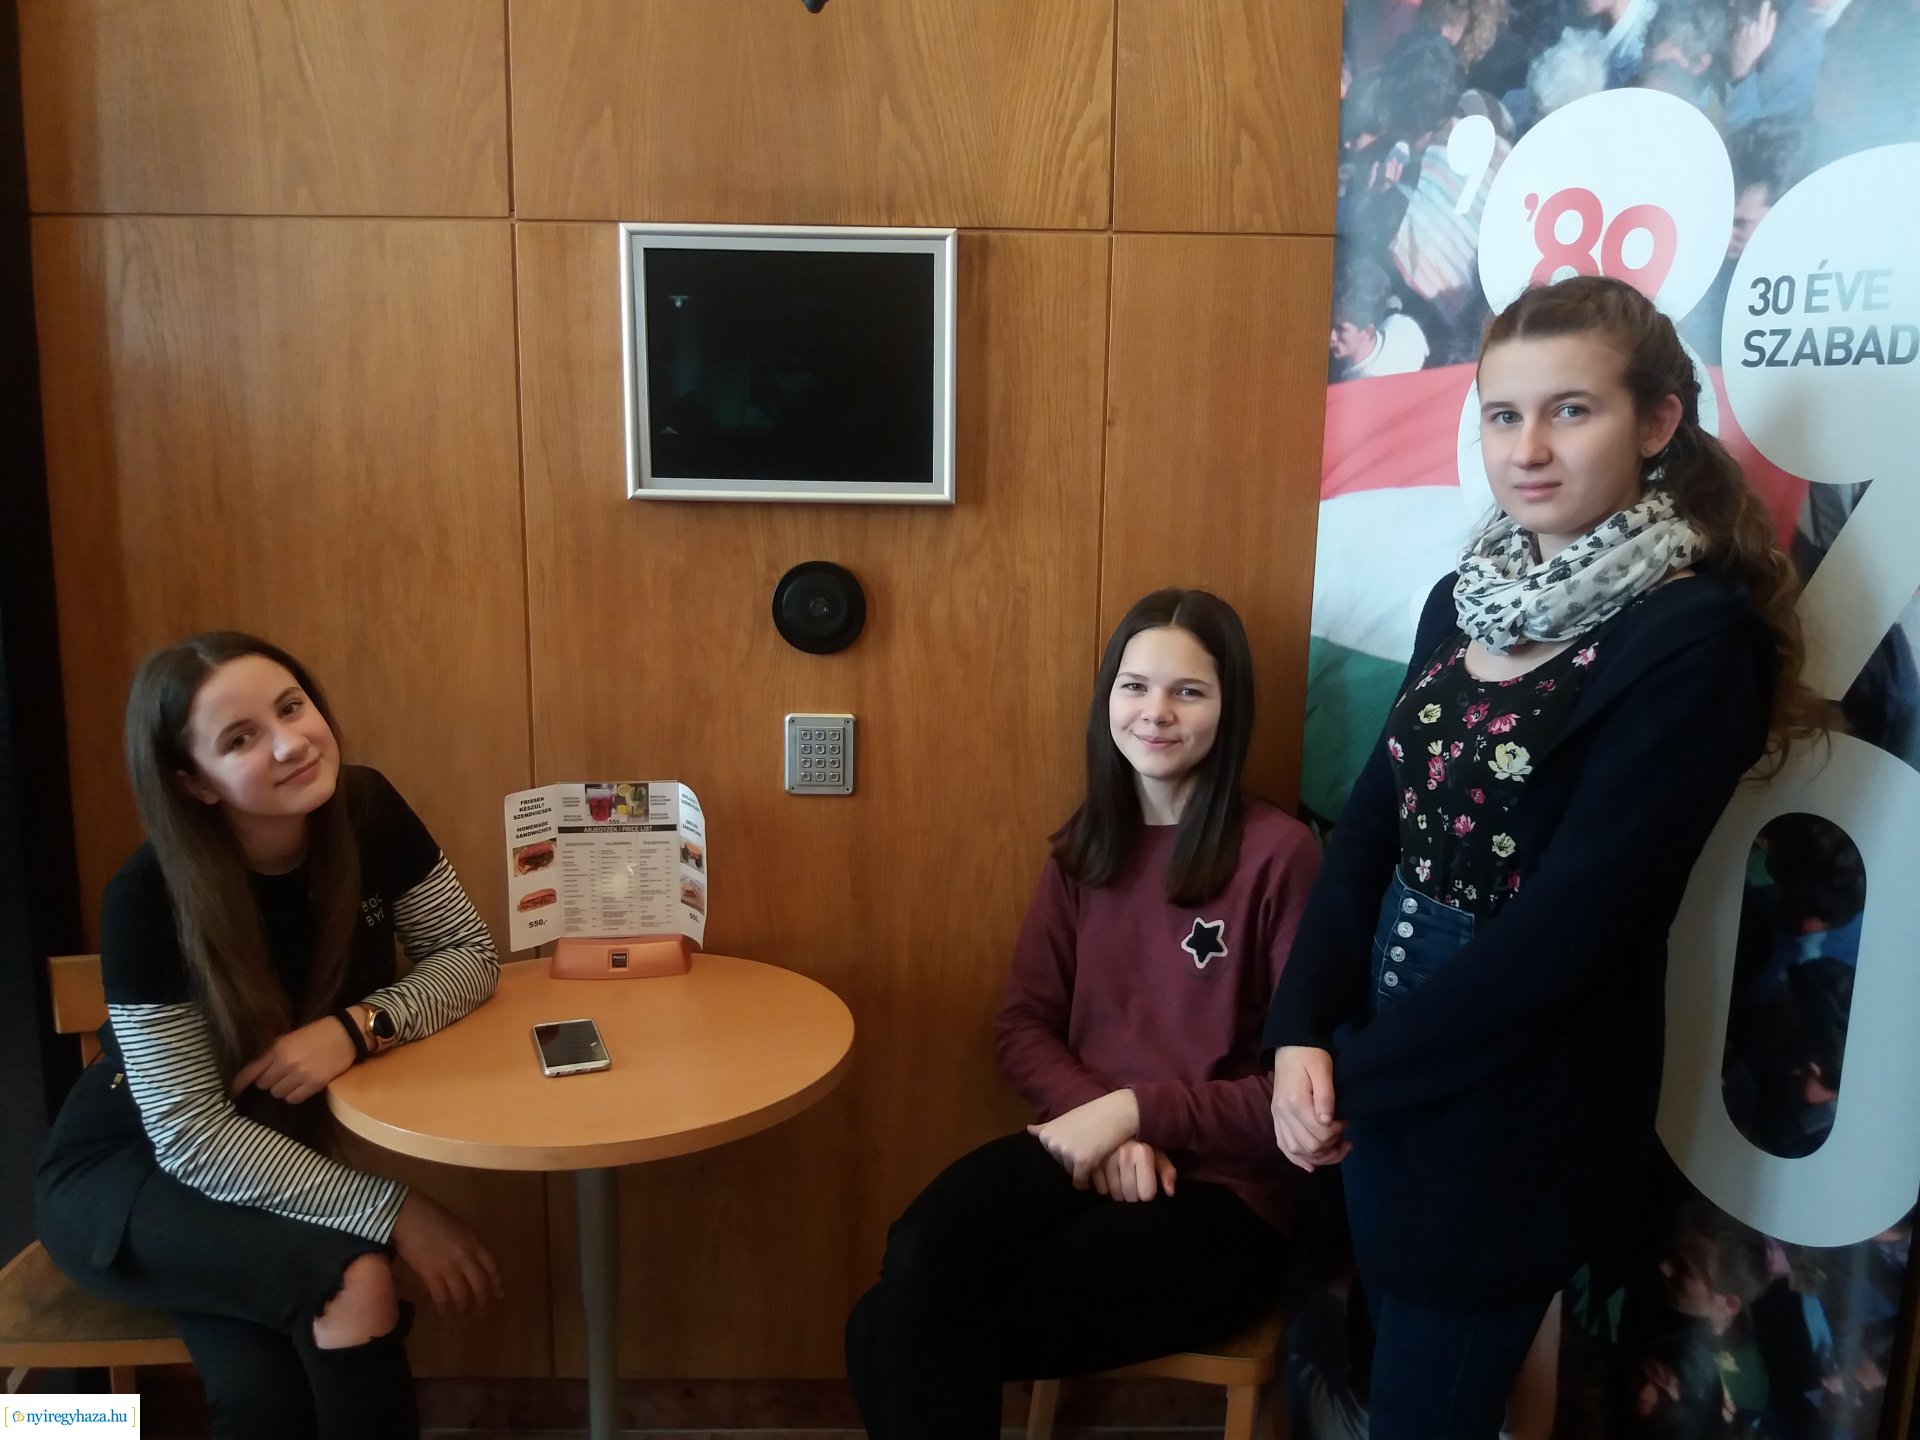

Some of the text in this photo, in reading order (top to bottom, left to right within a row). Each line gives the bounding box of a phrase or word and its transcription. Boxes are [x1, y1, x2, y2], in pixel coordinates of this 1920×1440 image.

[1747, 259, 1895, 317] 30 ÉVE
[1740, 323, 1919, 368] SZABAD
